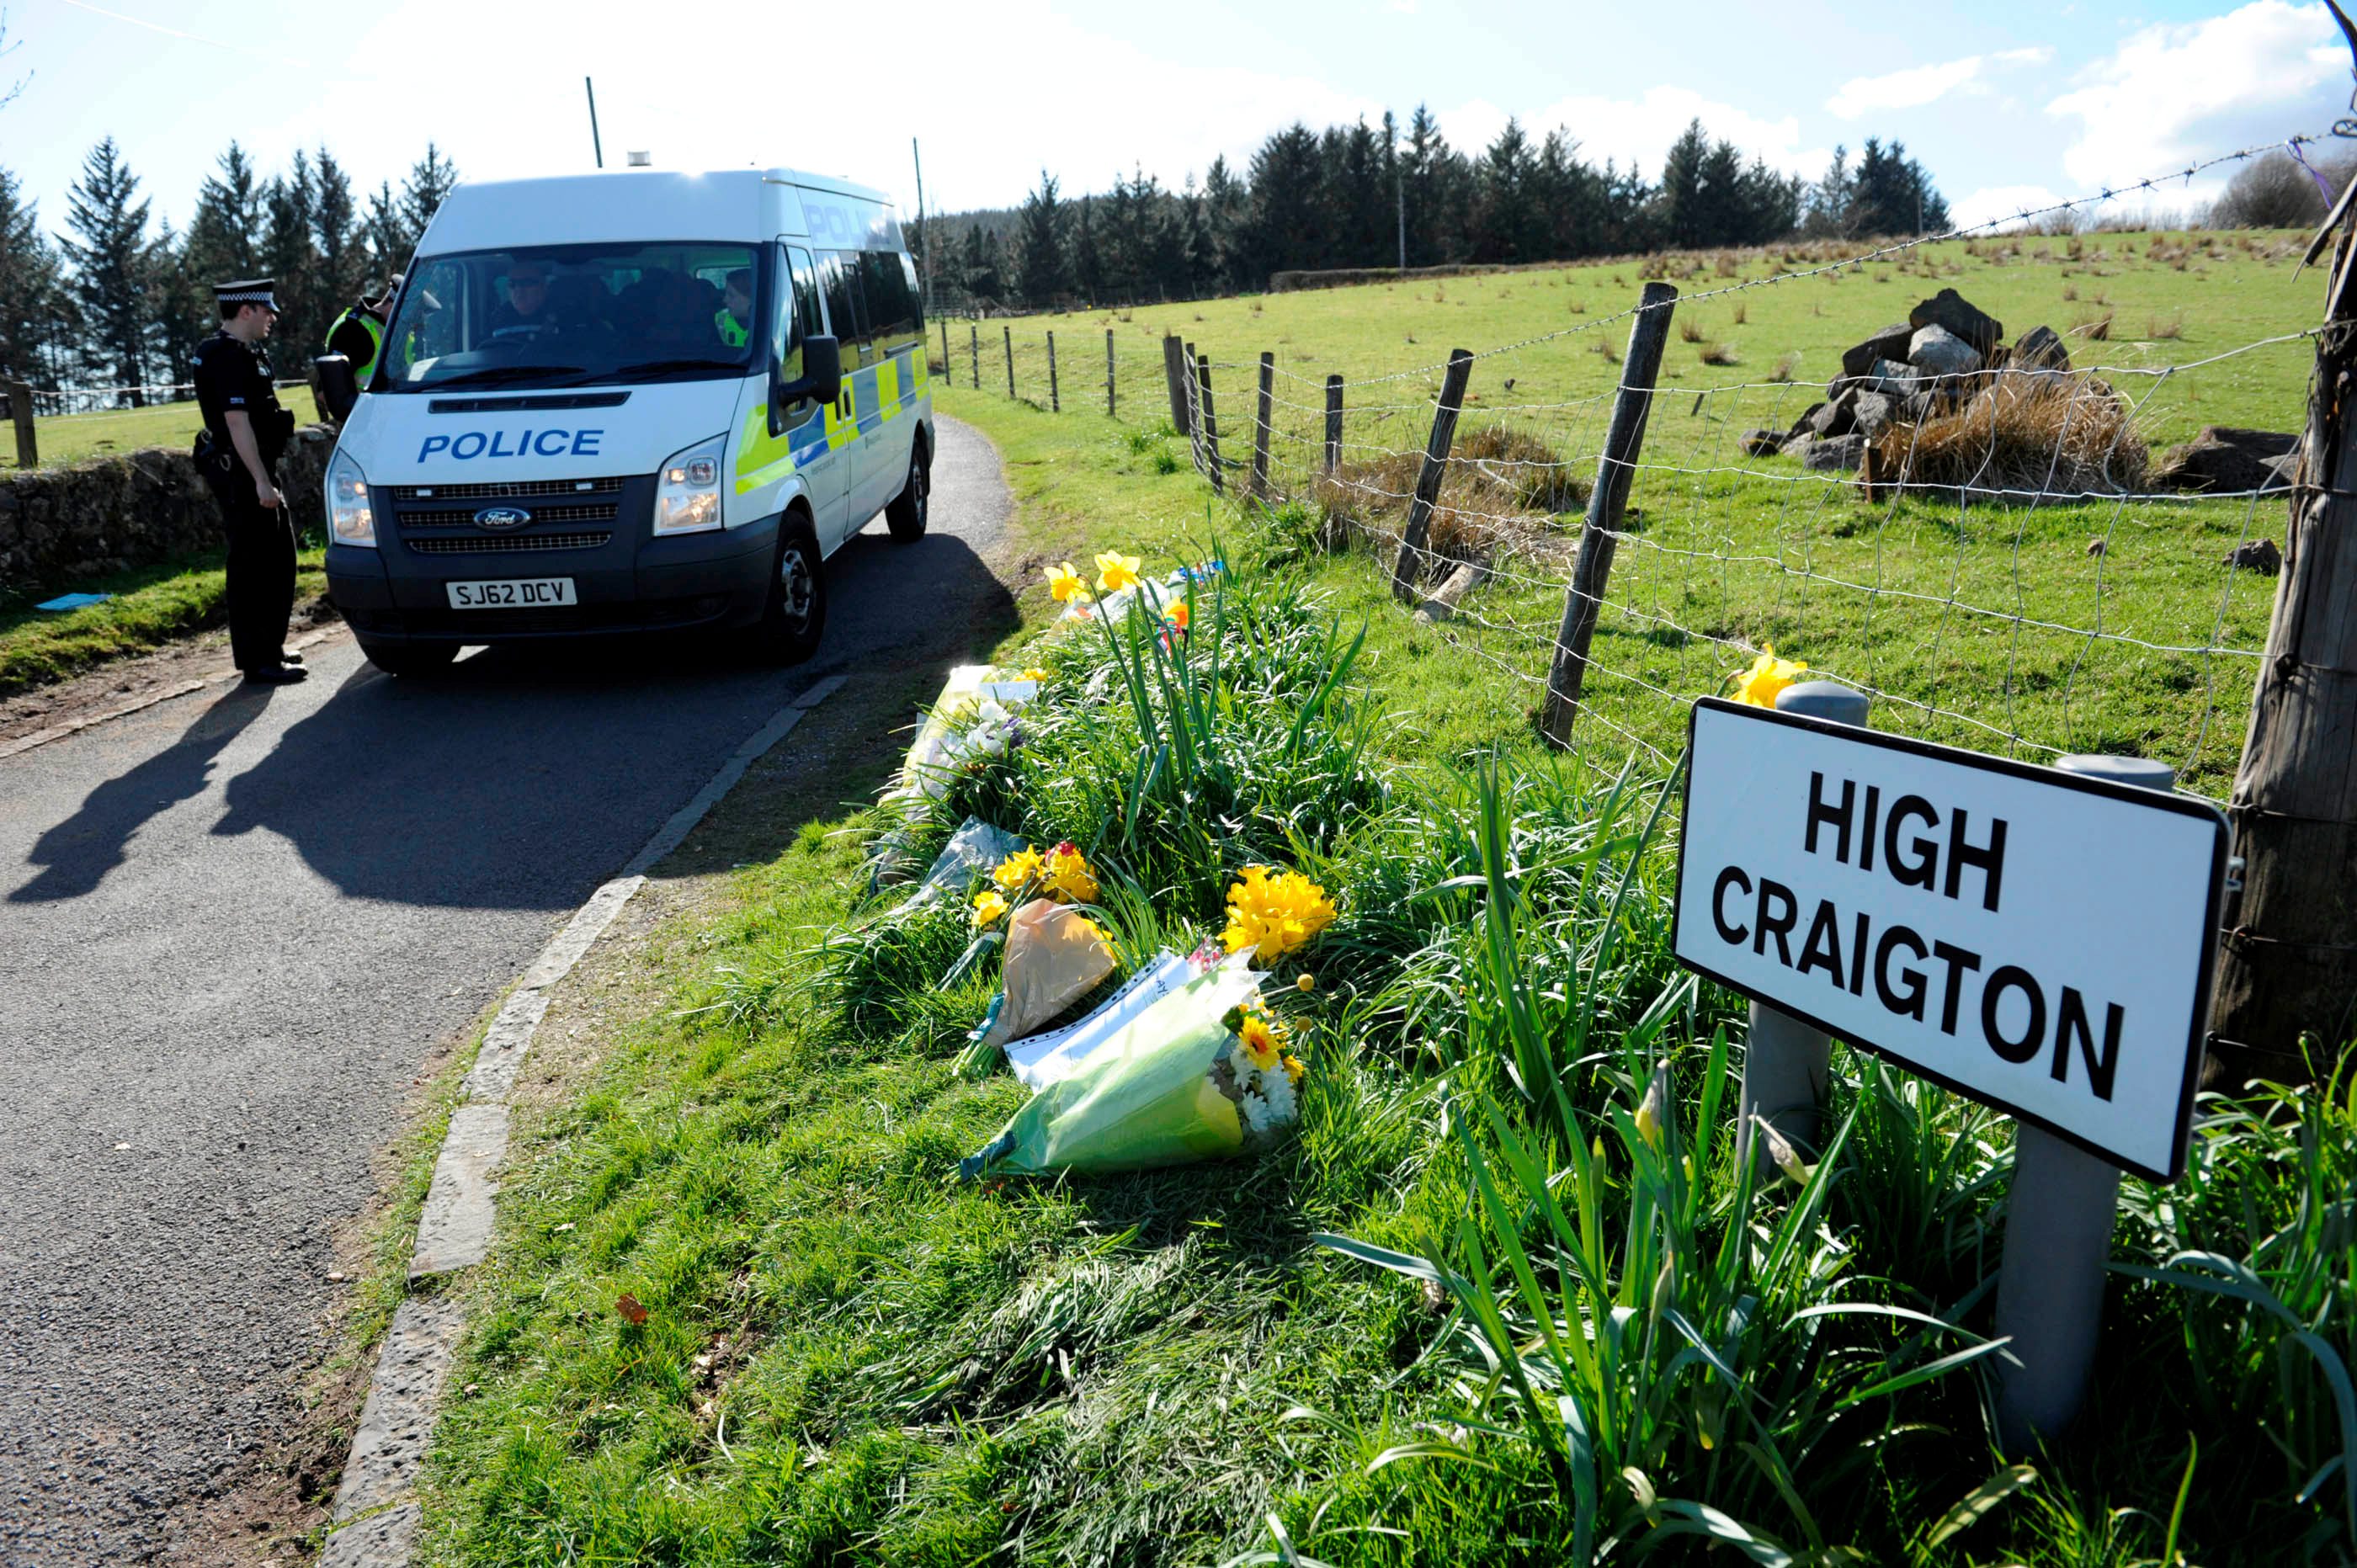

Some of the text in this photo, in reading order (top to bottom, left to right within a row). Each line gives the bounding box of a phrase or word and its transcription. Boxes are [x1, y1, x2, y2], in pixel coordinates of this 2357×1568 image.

[804, 204, 891, 244] POLI
[418, 429, 604, 463] POLICE
[485, 511, 516, 525] Ford
[455, 582, 563, 605] SJ62 DCV
[1804, 771, 2009, 913] HIGH
[1712, 865, 2126, 1103] CRAIGTON
